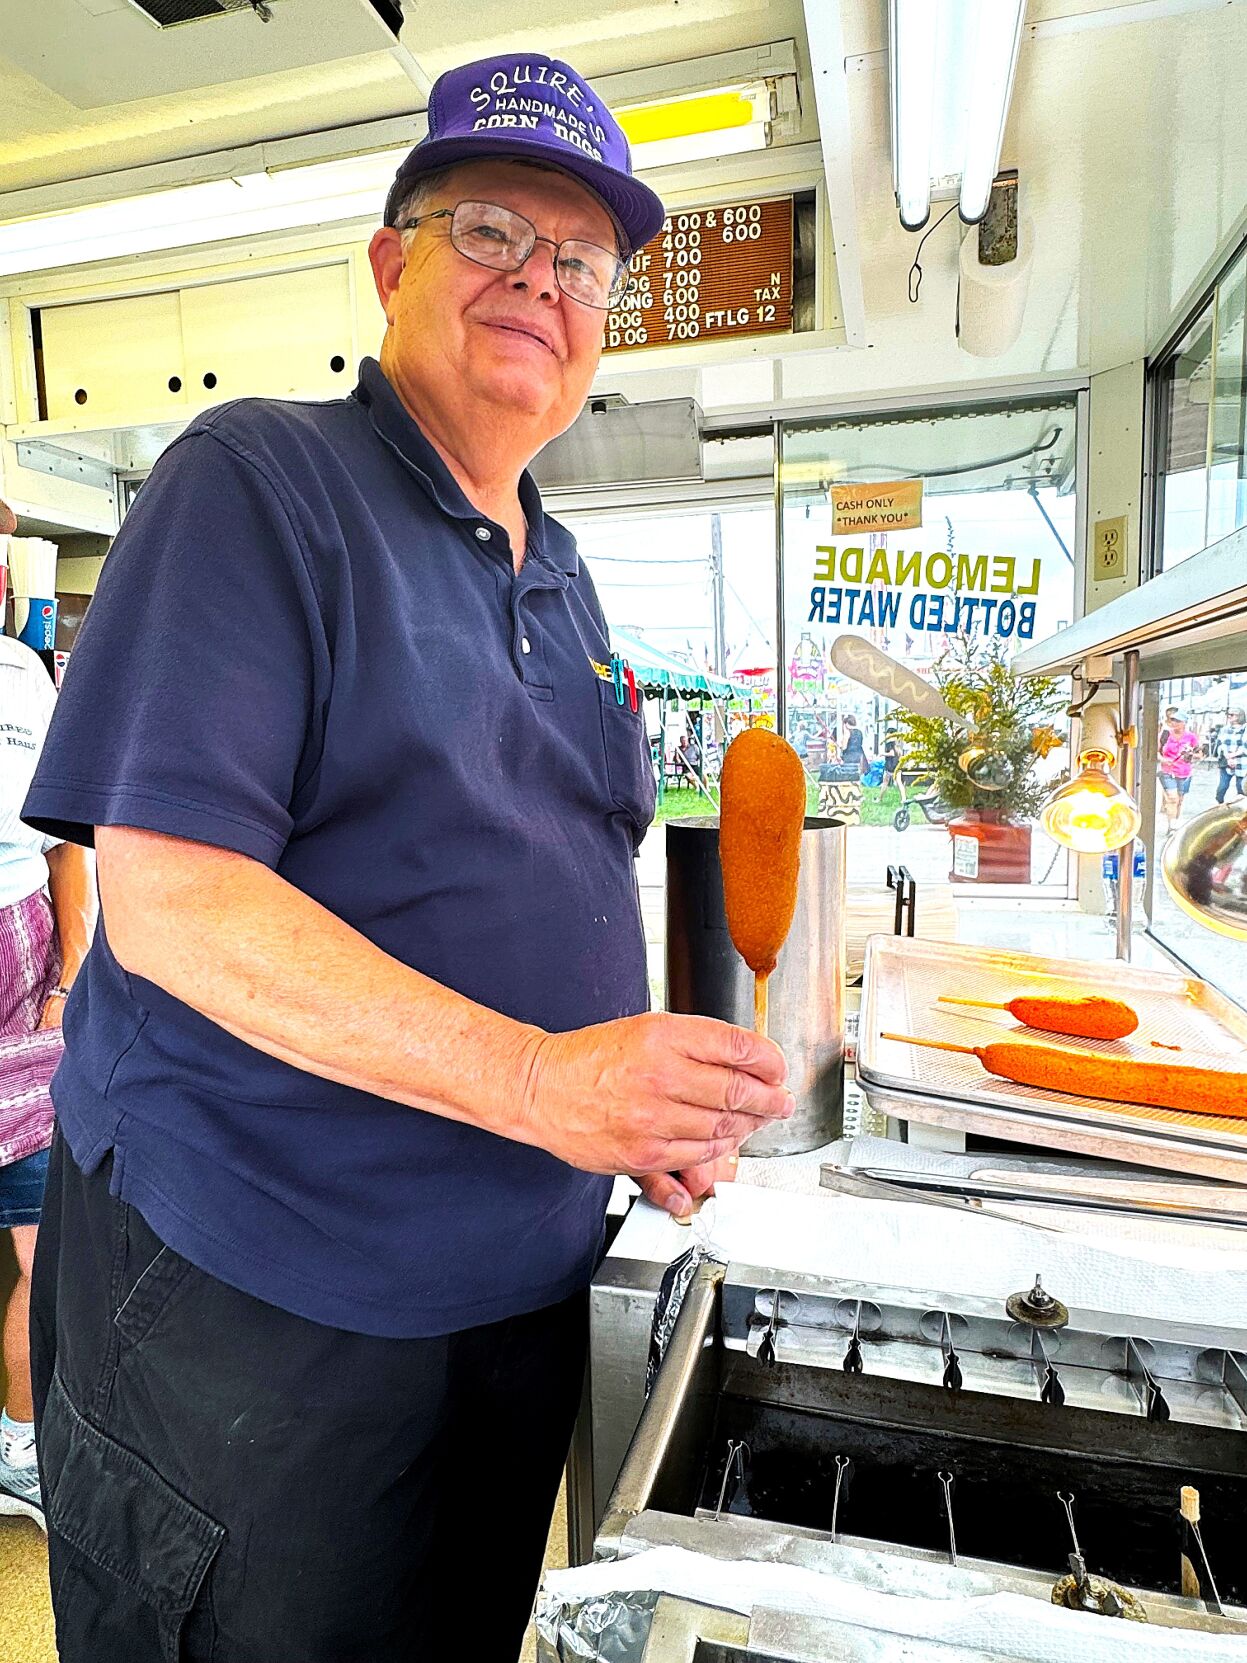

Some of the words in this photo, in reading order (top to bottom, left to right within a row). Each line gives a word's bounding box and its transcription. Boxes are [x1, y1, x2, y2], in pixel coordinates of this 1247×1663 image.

[472, 114, 539, 132] CORN
[495, 97, 587, 136] HANDMADE
[705, 211, 717, 228] &
[723, 205, 761, 225] 600
[662, 231, 701, 251] 400
[722, 223, 761, 243] 600
[663, 248, 702, 268] 700
[663, 269, 701, 288] 700
[663, 287, 698, 306] 600
[754, 287, 780, 301] TAX
[609, 312, 642, 330] DOG
[664, 304, 700, 322] 400
[757, 305, 775, 322] 12
[667, 321, 699, 340] 700
[836, 500, 863, 511] CASH
[866, 499, 894, 509] ONLY
